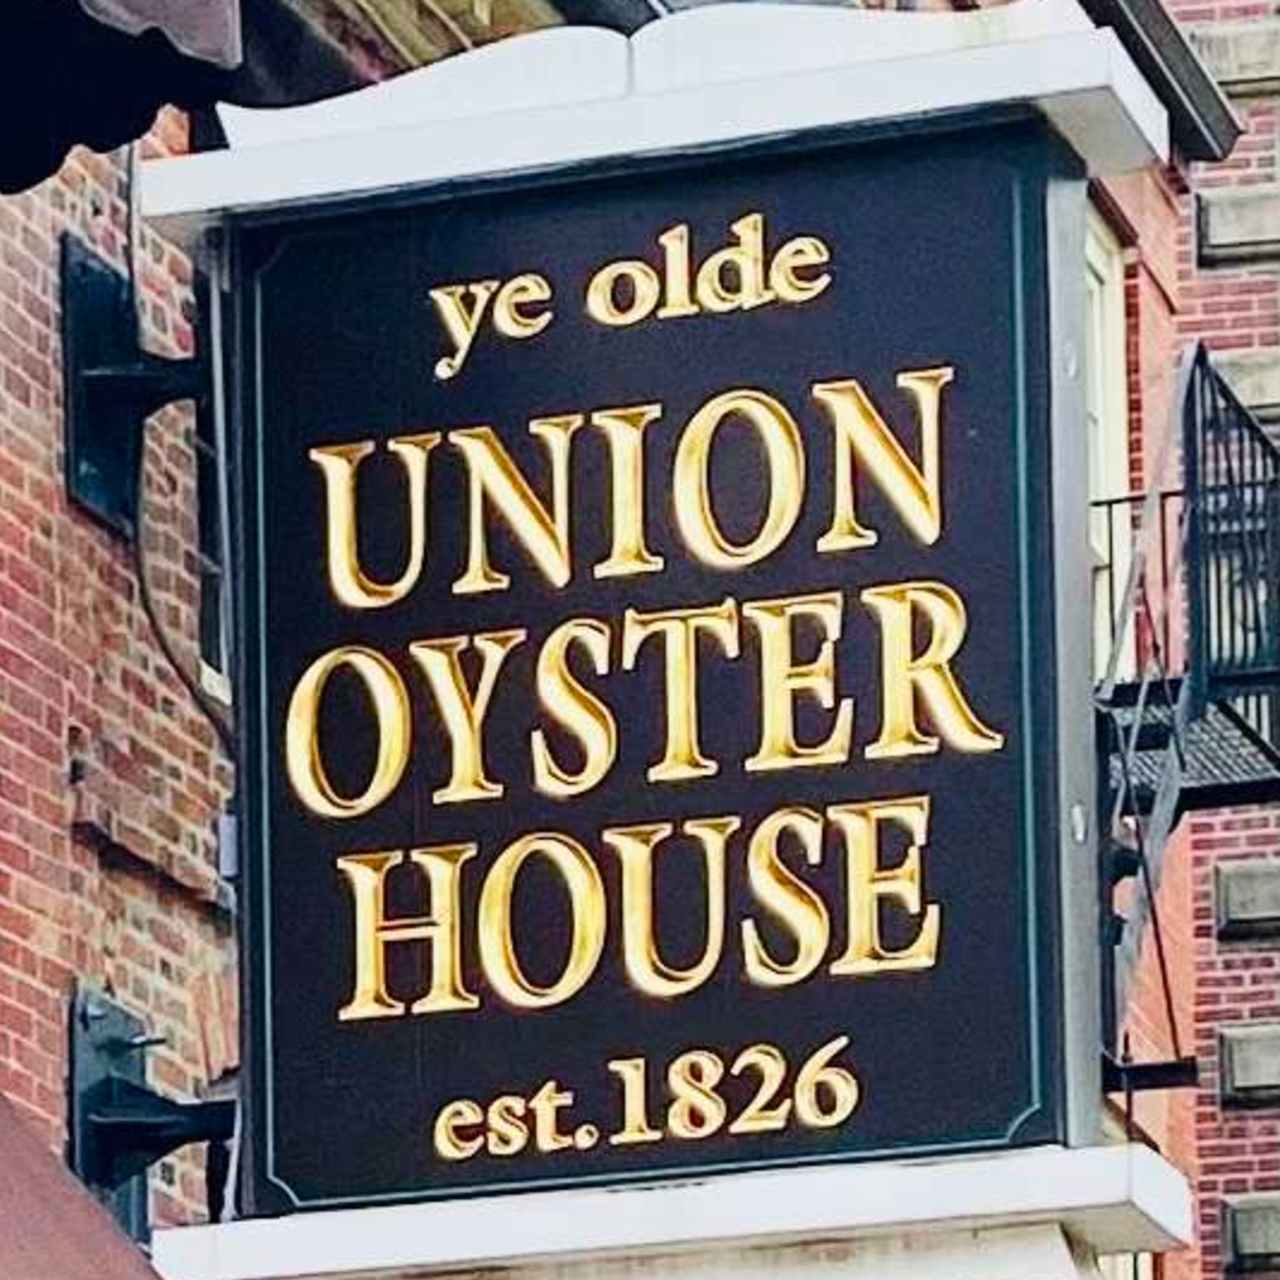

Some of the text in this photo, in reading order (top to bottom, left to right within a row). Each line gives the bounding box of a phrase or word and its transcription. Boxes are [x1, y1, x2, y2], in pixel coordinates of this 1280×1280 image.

[427, 212, 833, 381] ye olde
[308, 364, 955, 610] UNION
[283, 579, 1004, 821] OYSTER
[336, 794, 945, 1023] HOUSE
